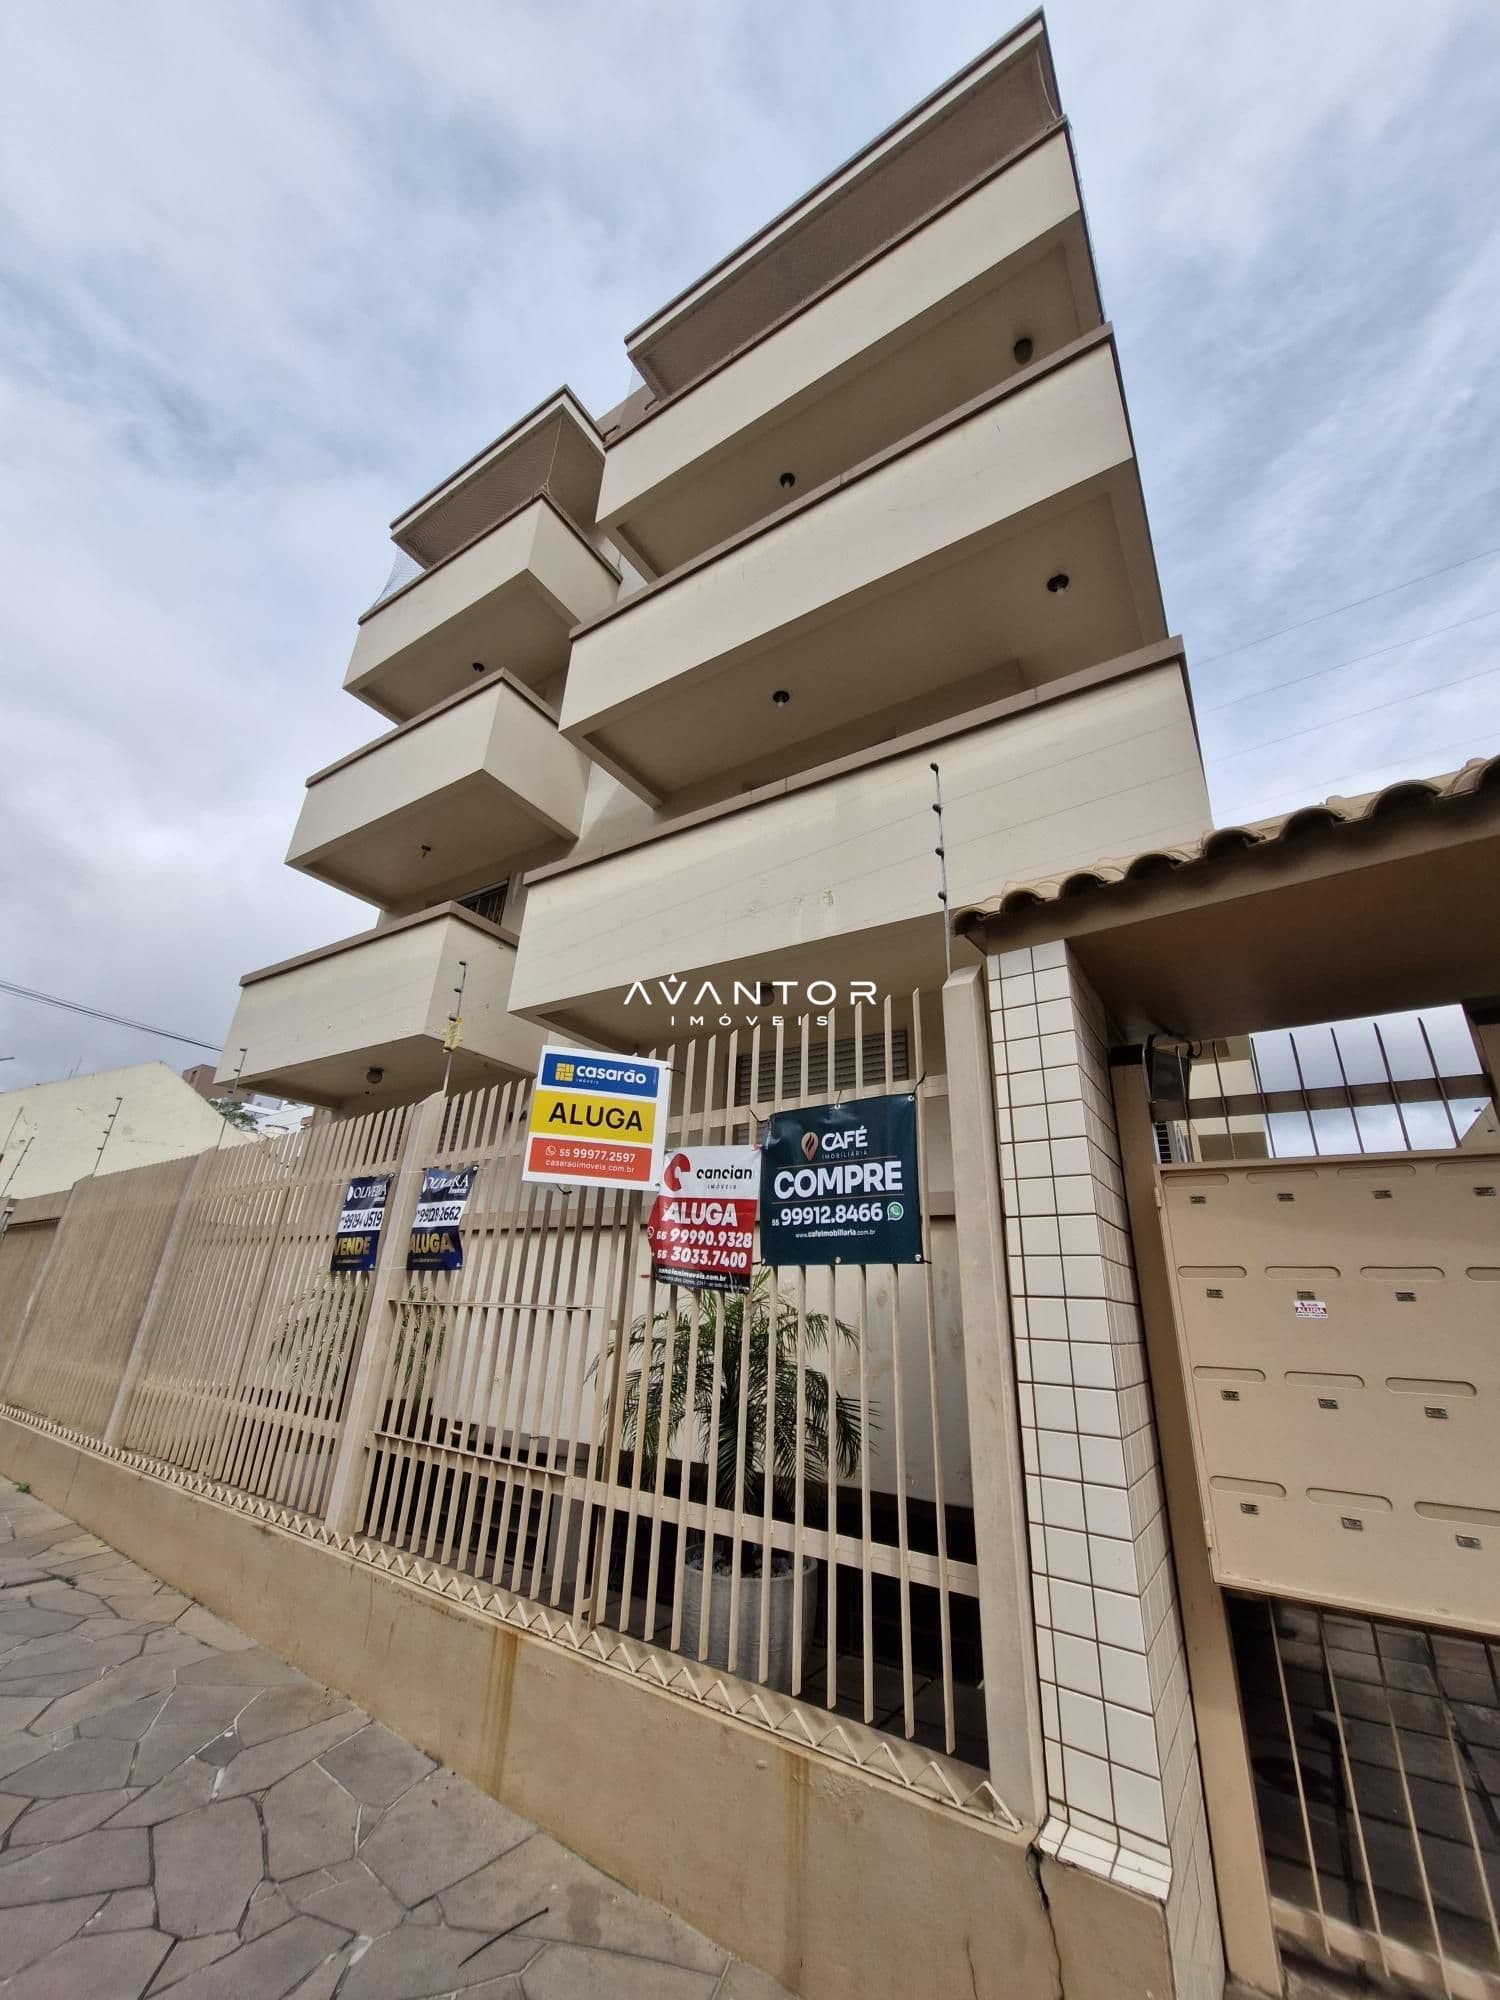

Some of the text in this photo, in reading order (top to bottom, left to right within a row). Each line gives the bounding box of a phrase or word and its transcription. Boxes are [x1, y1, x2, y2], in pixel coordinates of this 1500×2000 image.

[576, 1065, 647, 1085] casarão
[548, 1101, 643, 1132] ALUGA
[821, 1125, 868, 1151] CAFÉ
[573, 1148, 636, 1163] 99977.2597
[696, 1164, 753, 1180] cancian
[774, 1161, 903, 1199] COMPRE
[662, 1202, 738, 1226] ALUGA
[781, 1202, 884, 1226] 99912.8466
[336, 1237, 370, 1255] VENDE
[409, 1233, 454, 1254] ALUGA
[669, 1227, 753, 1249] 99990.9328
[670, 1246, 748, 1268] 3033.7400
